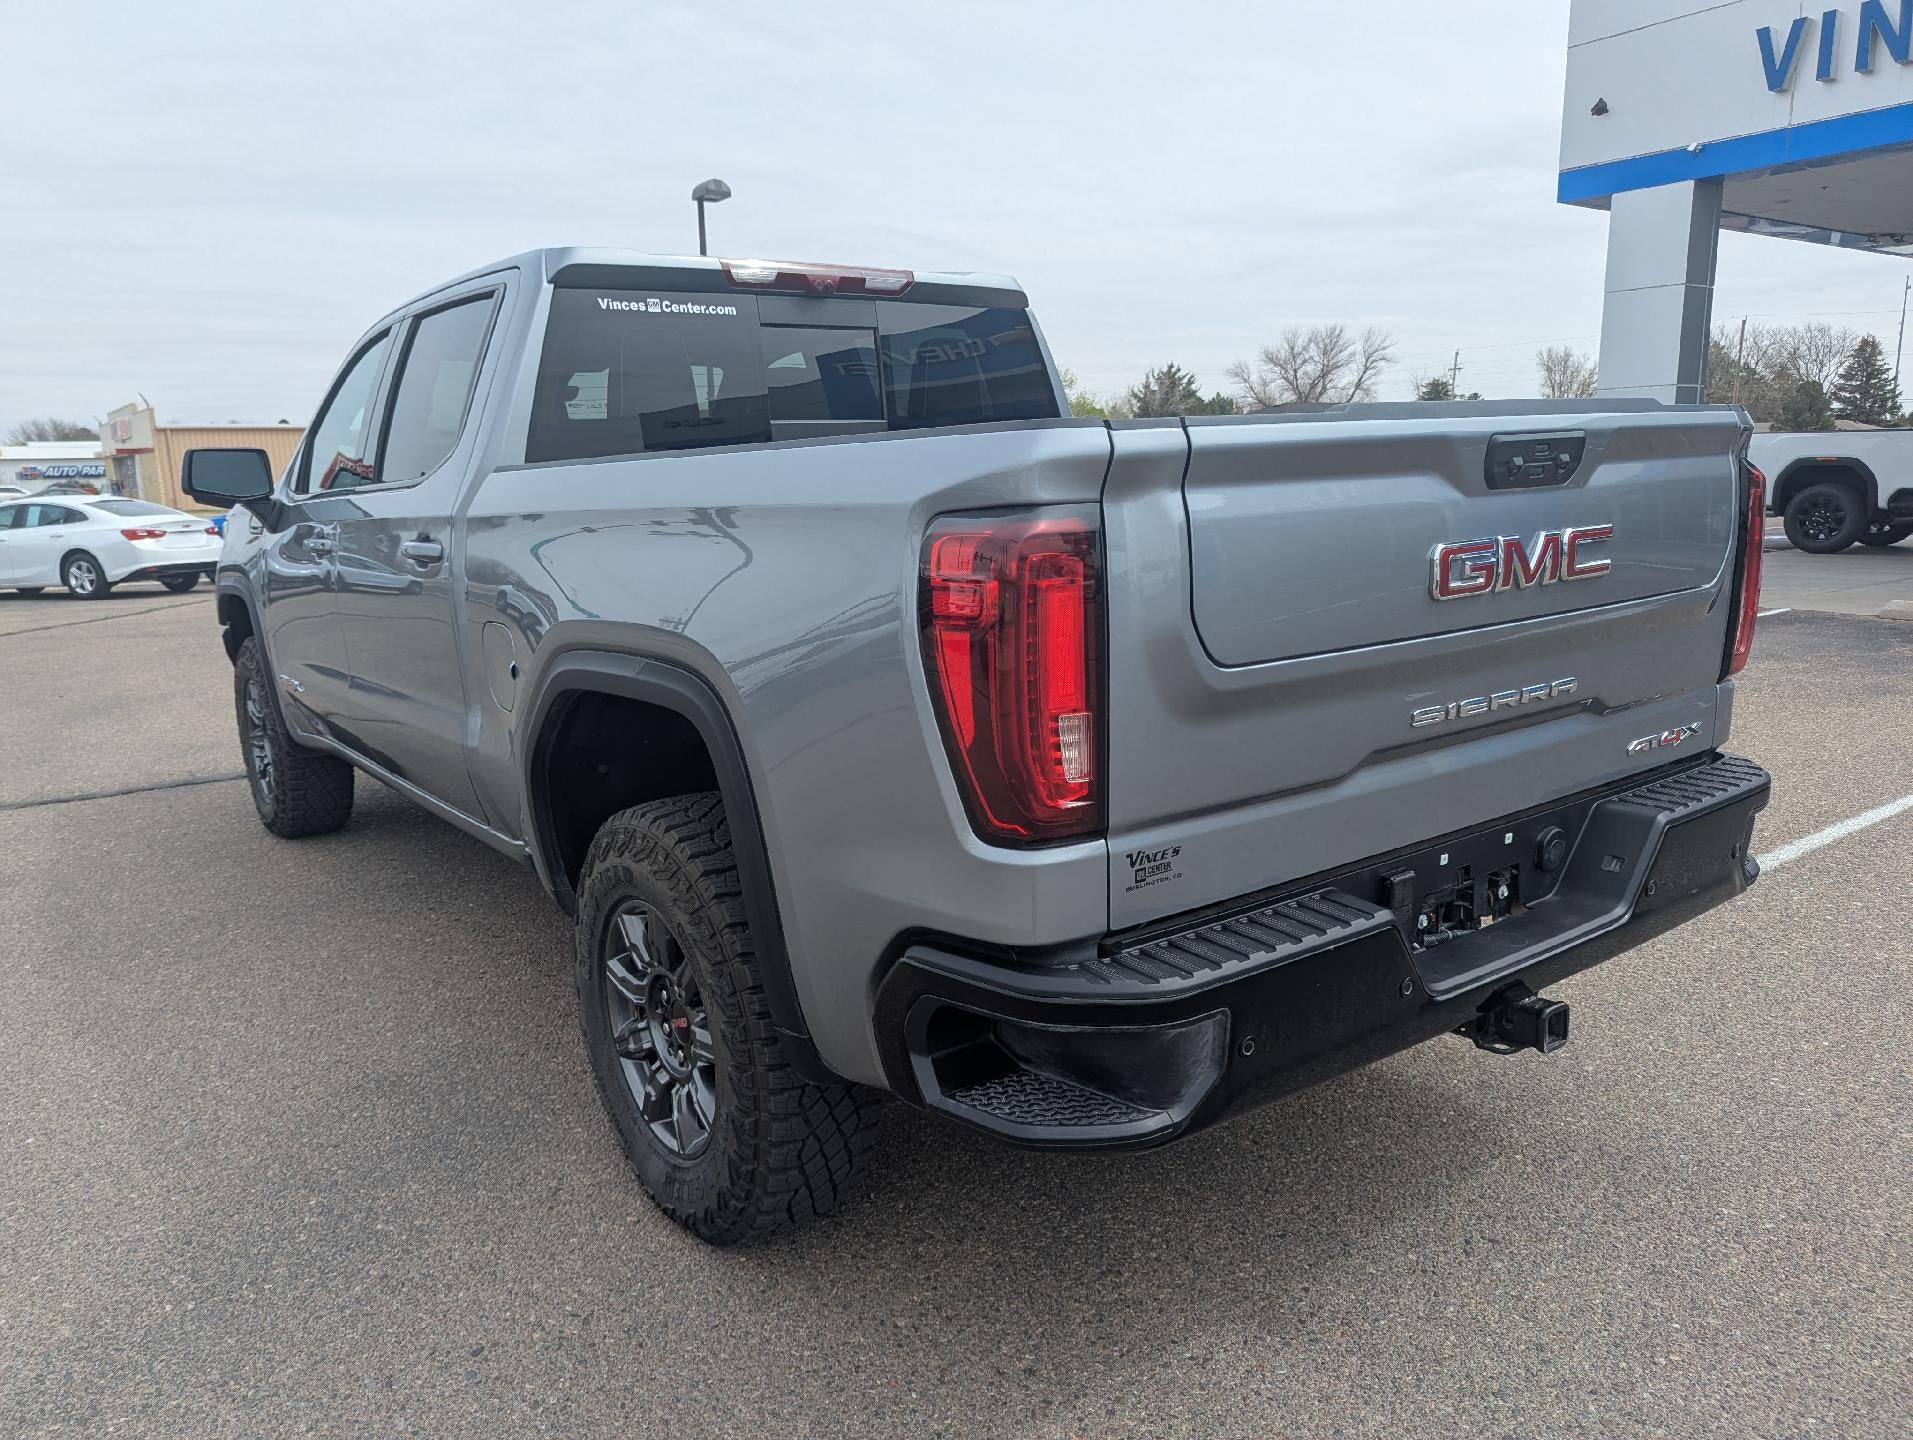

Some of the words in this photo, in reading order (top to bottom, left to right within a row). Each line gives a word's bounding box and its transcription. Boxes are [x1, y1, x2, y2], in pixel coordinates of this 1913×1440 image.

[1755, 0, 1913, 93] VIN
[44, 465, 77, 477] AUTO
[1429, 522, 1613, 600] GMC
[1410, 676, 1578, 728] SIERRA
[1626, 721, 1703, 756] AT4X
[1147, 861, 1171, 875] CENTER
